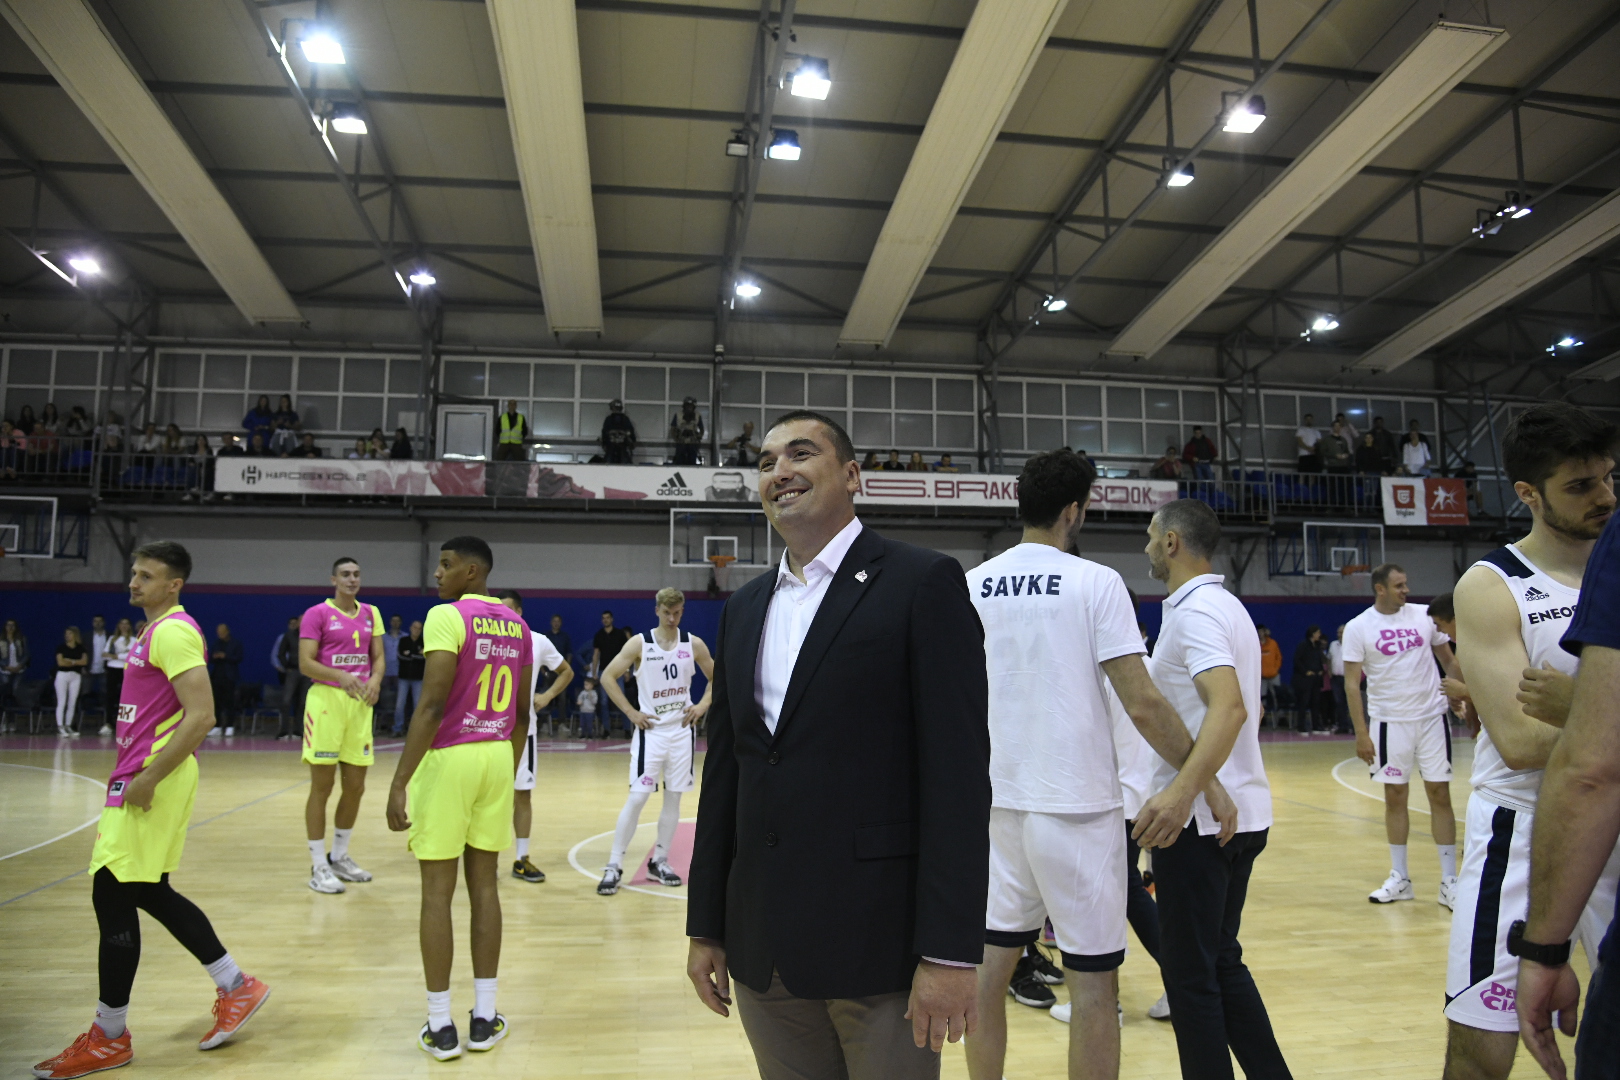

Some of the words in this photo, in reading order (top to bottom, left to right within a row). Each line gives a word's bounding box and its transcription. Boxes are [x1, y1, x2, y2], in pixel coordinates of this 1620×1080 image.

[656, 487, 693, 496] adidas
[981, 575, 1062, 598] SAVKE
[473, 617, 523, 639] CAZALON
[1380, 629, 1420, 641] DEKI
[352, 630, 360, 648] 1
[334, 655, 367, 664] BEMA
[662, 663, 678, 680] 10
[476, 664, 513, 712] 10
[1490, 982, 1517, 999] DE
[1483, 996, 1517, 1011] CIA
